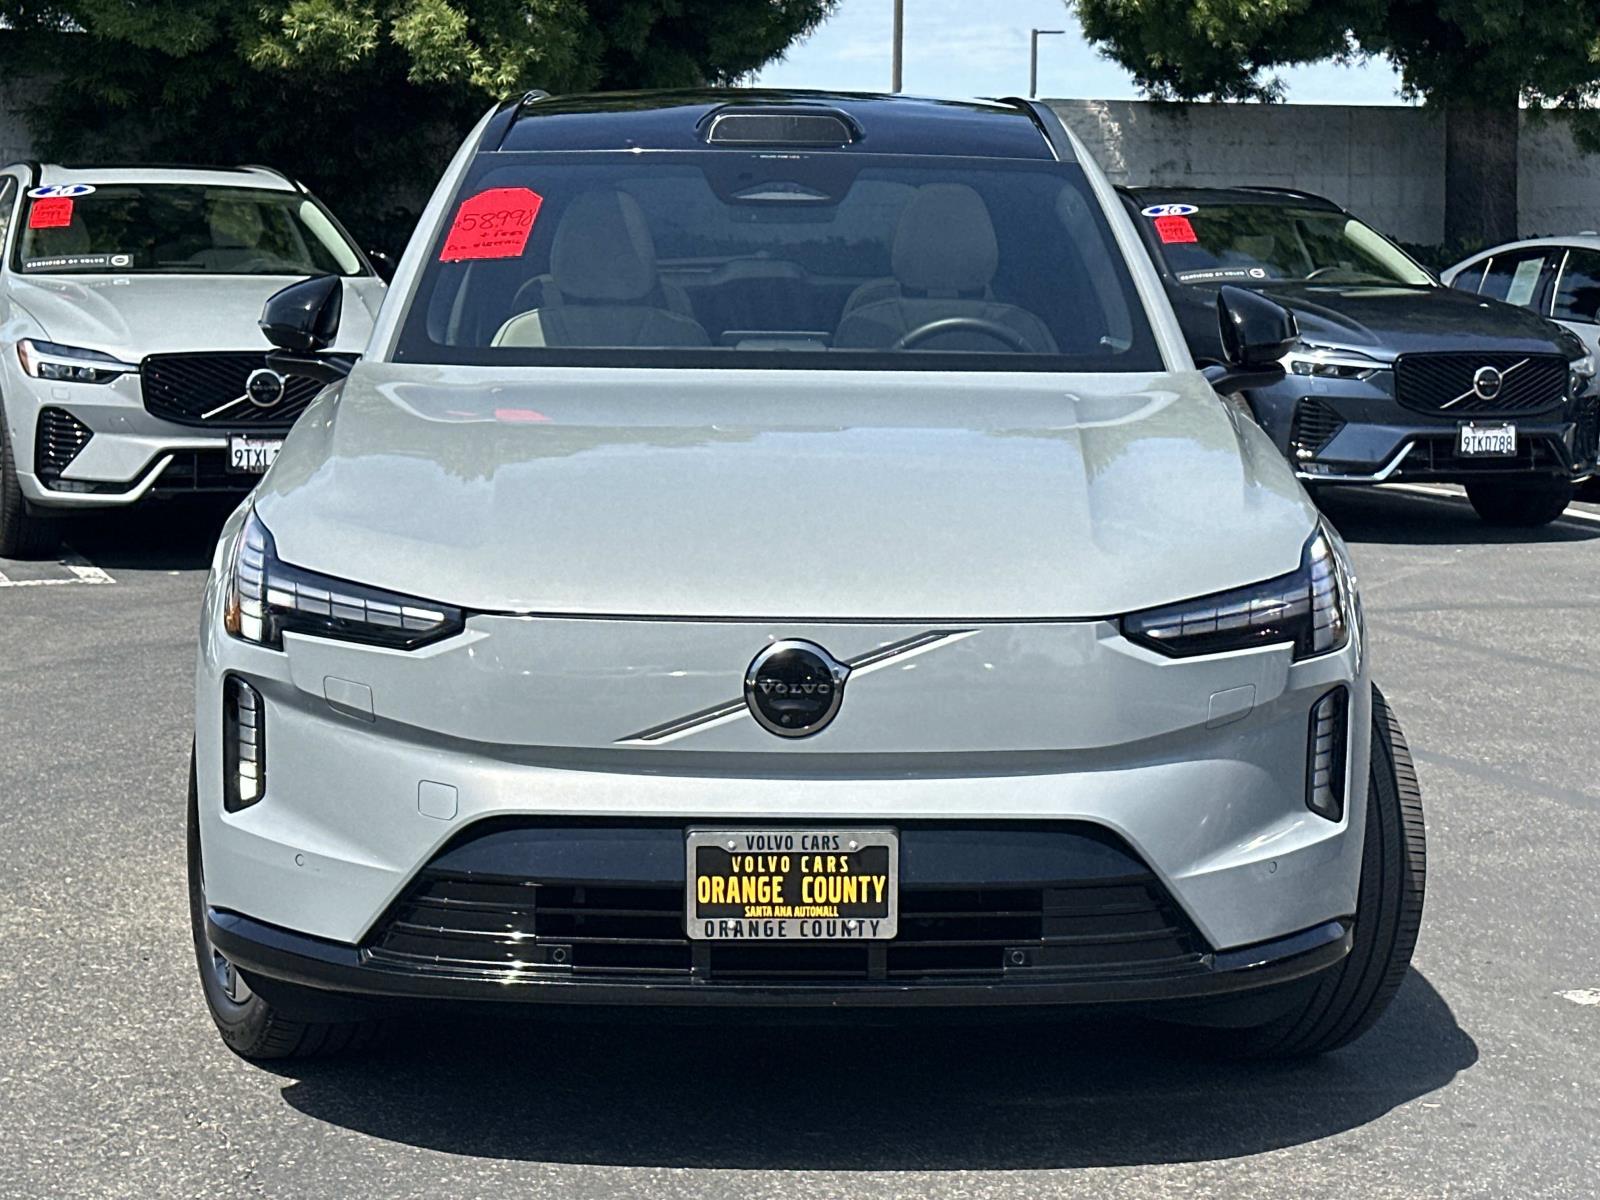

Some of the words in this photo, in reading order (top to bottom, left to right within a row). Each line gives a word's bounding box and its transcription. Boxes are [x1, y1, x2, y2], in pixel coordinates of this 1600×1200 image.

[758, 683, 830, 695] VOLVO
[745, 835, 793, 850] VOLVO
[801, 835, 840, 850] CARS
[732, 855, 790, 873] VOLVO
[801, 855, 849, 873] CARS
[697, 875, 784, 904] ORANGE
[802, 875, 886, 904] COUNTY
[744, 905, 773, 917] SANTA
[773, 905, 793, 917] ANA
[793, 905, 839, 917] AUTOMALL
[704, 920, 787, 938] ORANGE
[800, 920, 880, 938] COUNTY
